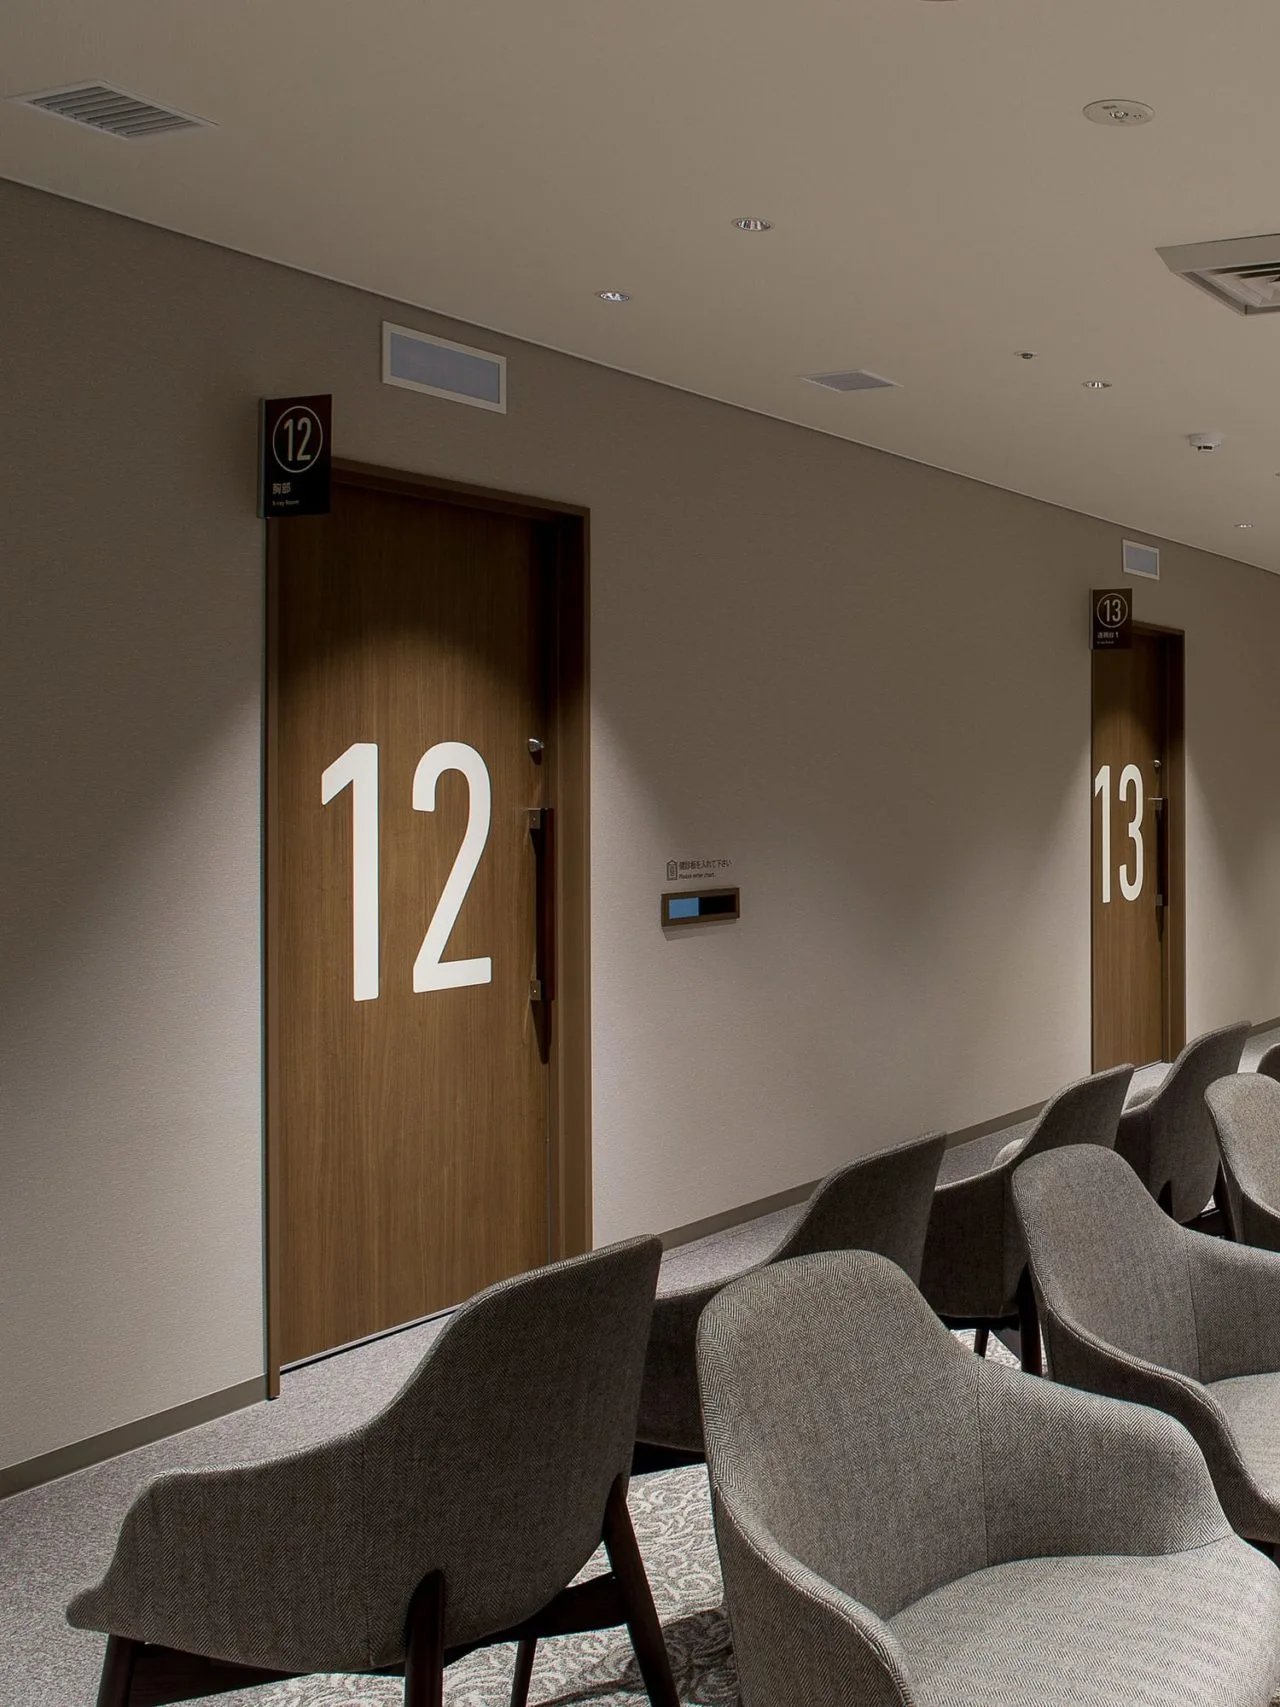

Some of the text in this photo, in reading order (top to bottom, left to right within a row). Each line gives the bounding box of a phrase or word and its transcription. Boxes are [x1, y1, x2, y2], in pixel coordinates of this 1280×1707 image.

[284, 417, 312, 462] 12
[1104, 598, 1121, 622] 13
[321, 741, 492, 1002] 12
[1094, 763, 1144, 904] 13
